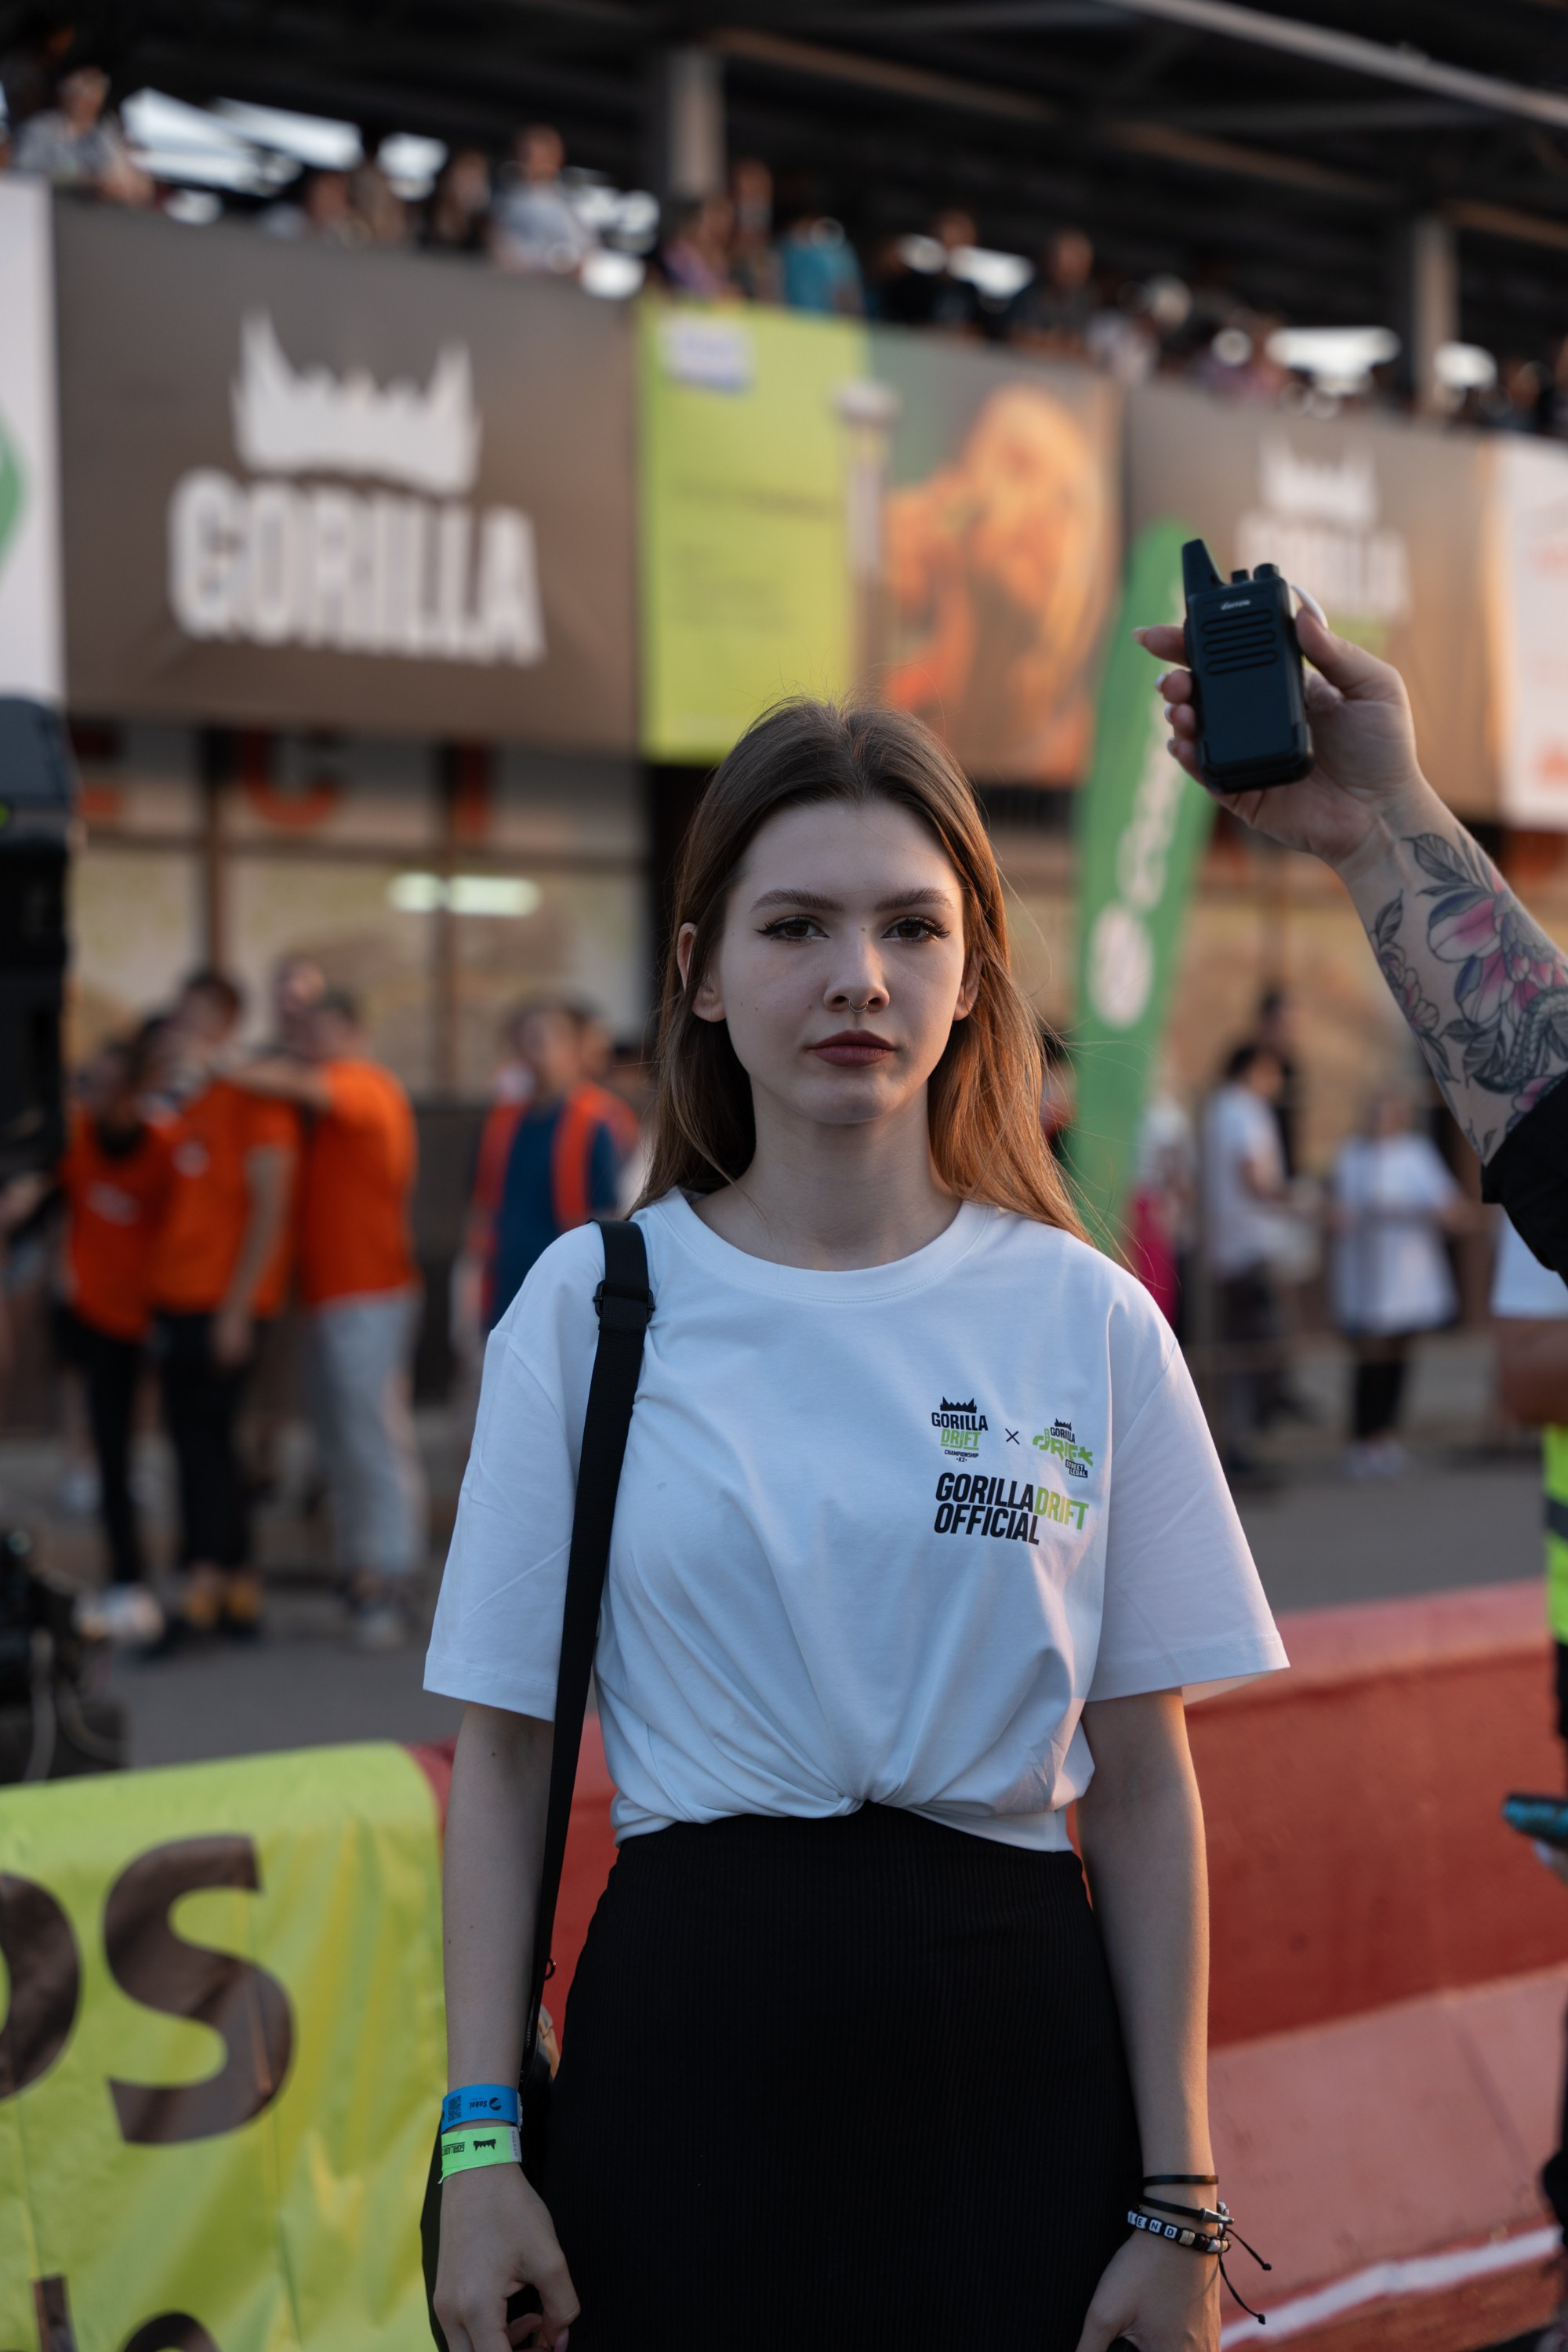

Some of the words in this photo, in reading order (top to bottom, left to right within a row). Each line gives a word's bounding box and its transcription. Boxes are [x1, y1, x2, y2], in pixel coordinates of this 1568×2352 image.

[167, 466, 546, 666] GORILLA
[931, 1412, 989, 1431] GORILLA
[940, 1428, 982, 1450] DRIFT
[1050, 1427, 1076, 1444] GORILLA
[944, 1450, 979, 1458] CHAMPIONSHIP
[1066, 1460, 1084, 1471] STREET
[1069, 1468, 1087, 1477] LEGAL
[934, 1503, 1040, 1545] OFFICIAL
